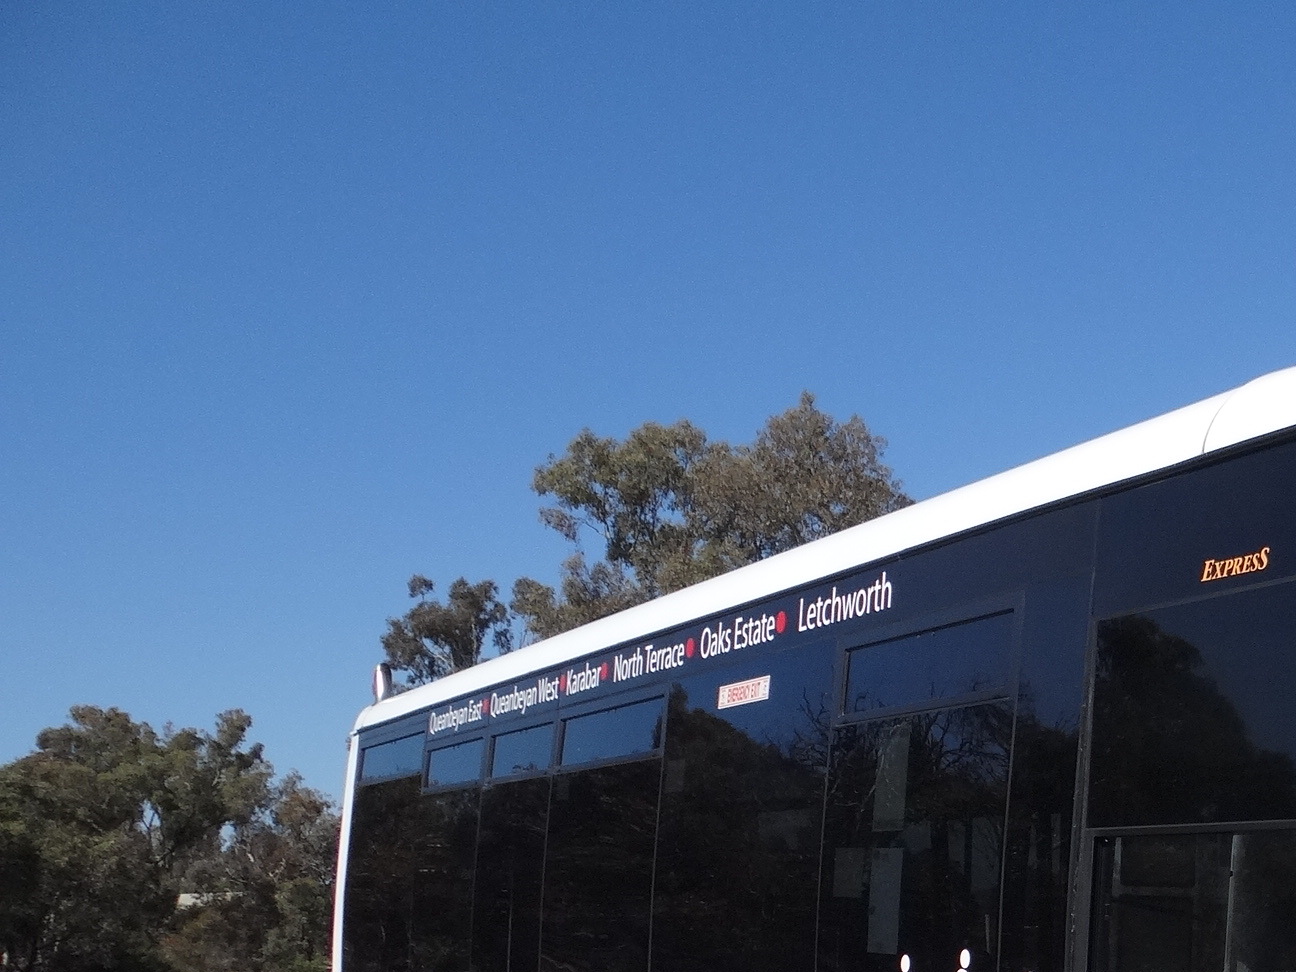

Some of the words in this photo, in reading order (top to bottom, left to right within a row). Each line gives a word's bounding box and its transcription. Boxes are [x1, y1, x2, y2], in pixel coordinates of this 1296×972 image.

[1200, 546, 1270, 582] EXPRESS
[429, 705, 468, 734] Queanbeyan
[468, 700, 482, 722] East
[490, 685, 537, 718] Queanbeyan
[538, 677, 559, 703] West
[566, 662, 602, 696] Karabar
[613, 647, 643, 682] North
[645, 643, 685, 673] Terrace
[700, 622, 731, 659] Oaks
[734, 613, 775, 650] Estate
[798, 571, 892, 632] Letchworth
